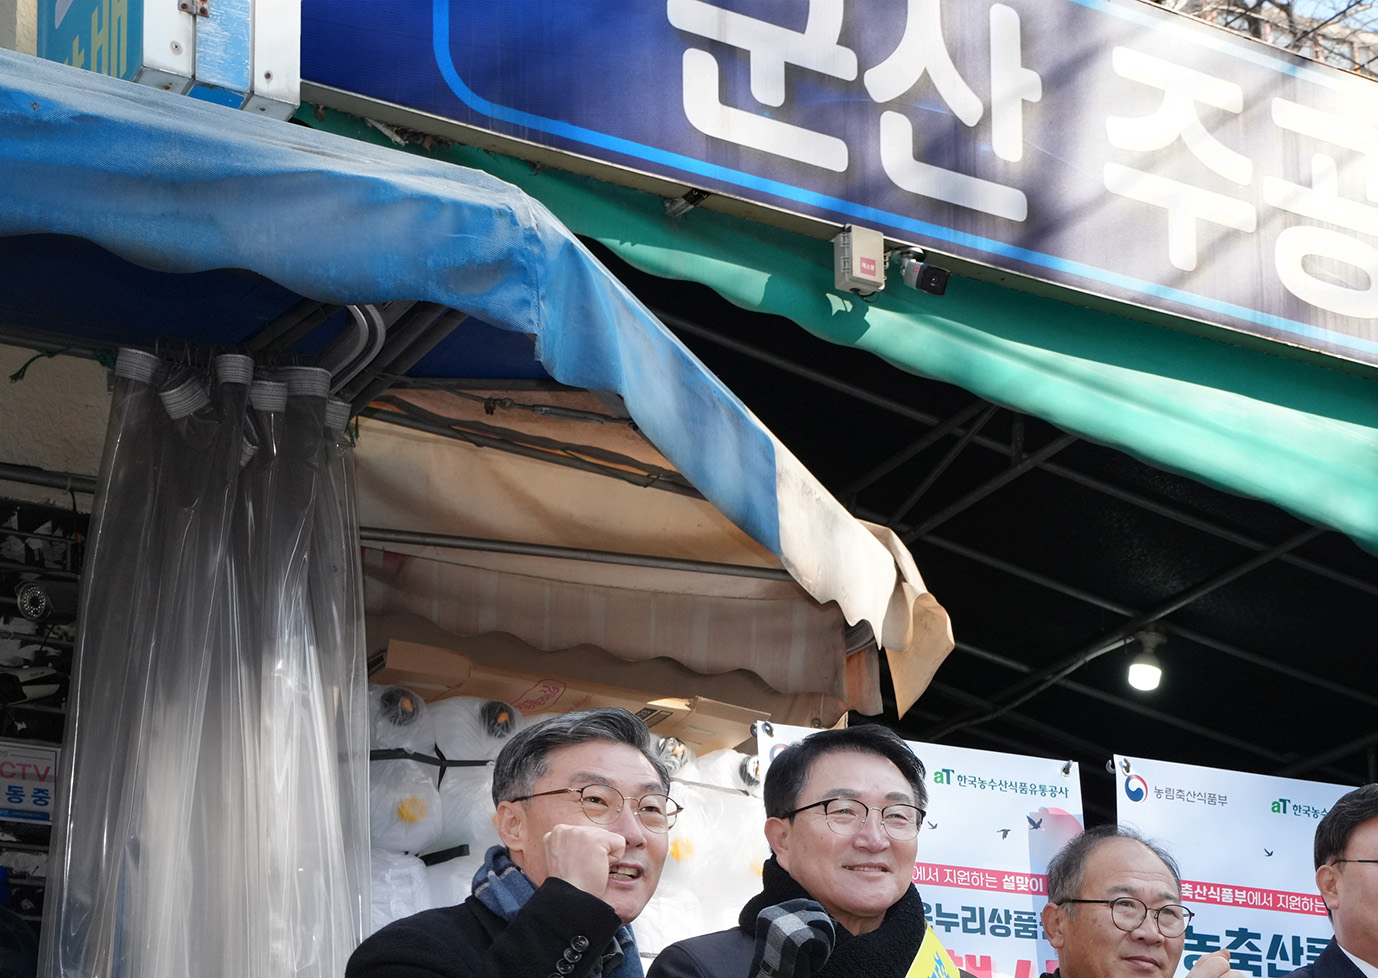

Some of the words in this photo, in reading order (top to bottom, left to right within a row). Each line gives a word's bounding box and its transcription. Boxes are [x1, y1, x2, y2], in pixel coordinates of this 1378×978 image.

[667, 0, 1042, 222] 군산
[934, 768, 954, 785] aT
[957, 774, 1069, 799] 한국농수산식품유통공사
[1153, 786, 1228, 807] 농림축산식품부
[1271, 798, 1291, 814] aT
[943, 869, 998, 888] 지원하는
[1002, 875, 1043, 892] 설맞이
[1276, 894, 1327, 914] 지원하는
